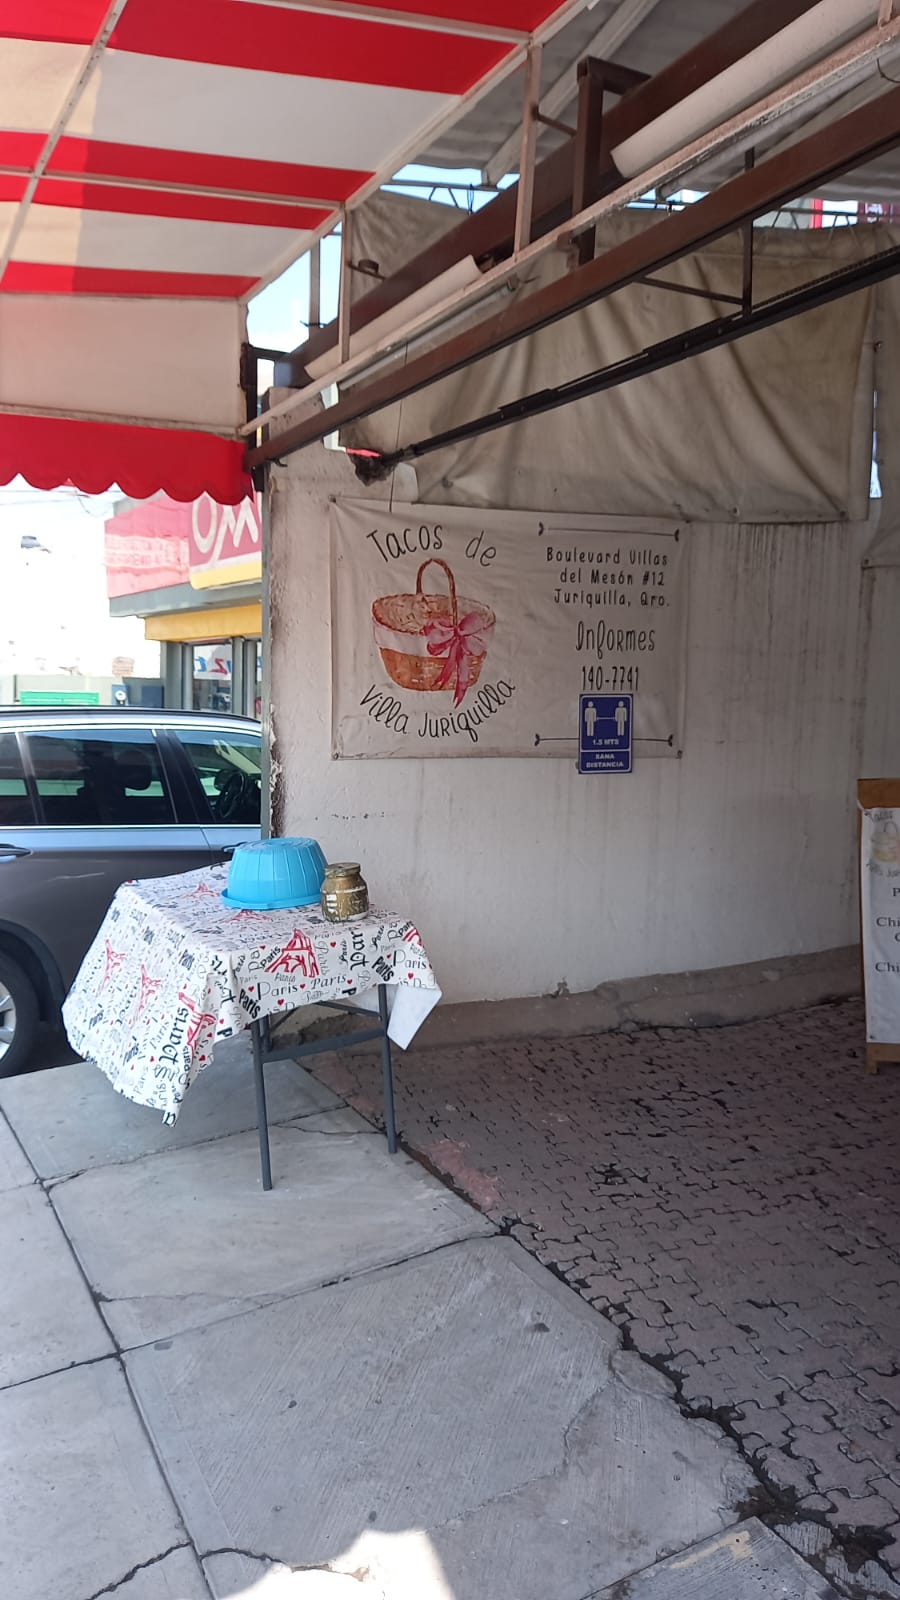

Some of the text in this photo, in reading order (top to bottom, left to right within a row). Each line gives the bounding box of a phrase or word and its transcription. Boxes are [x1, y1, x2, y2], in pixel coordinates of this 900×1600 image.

[366, 524, 497, 567] Tacos de
[546, 547, 668, 566] Boulevard Villas
[560, 568, 665, 586] del Mesón #12
[554, 588, 670, 608] Juriquilla, Qro.
[576, 620, 656, 660] Informes
[582, 666, 639, 691] 140-7741
[359, 679, 516, 743] Villa Juriquilla
[371, 955, 394, 982] Paris
[393, 949, 428, 970] Paris
[257, 981, 298, 1001] Paris
[311, 974, 347, 990] Paris
[238, 988, 261, 1020] Paris
[158, 1007, 190, 1065] Paris
